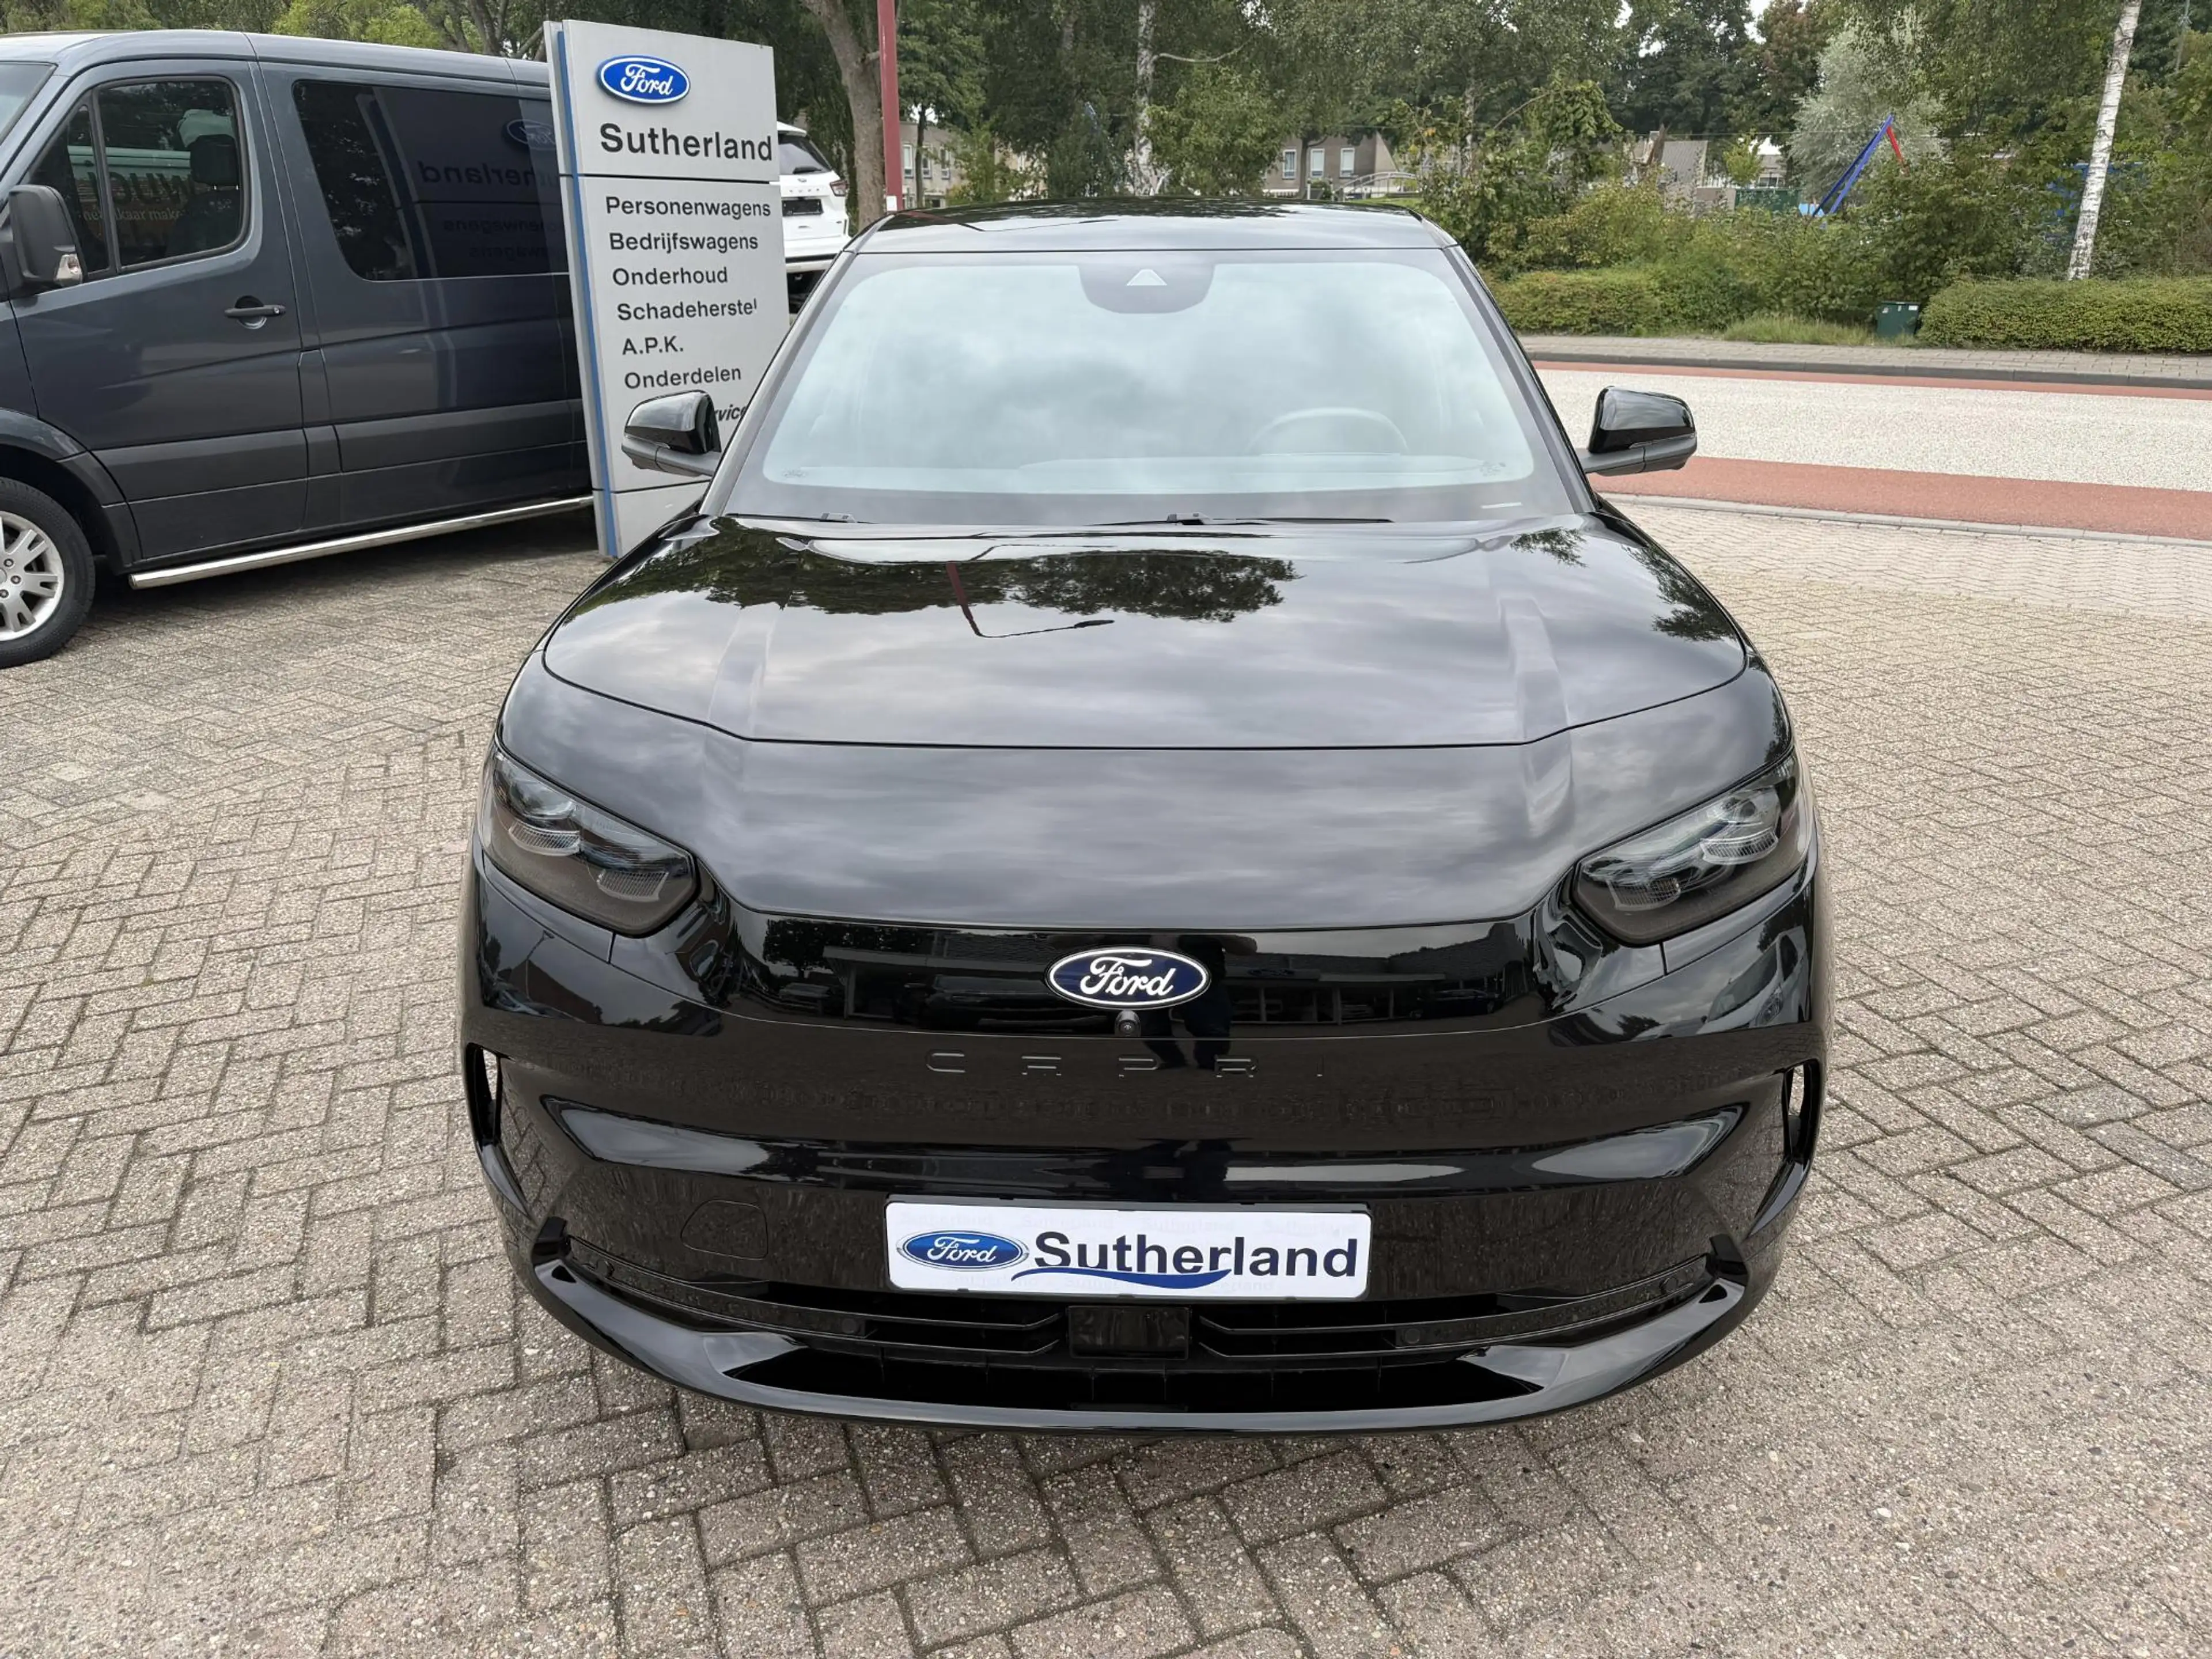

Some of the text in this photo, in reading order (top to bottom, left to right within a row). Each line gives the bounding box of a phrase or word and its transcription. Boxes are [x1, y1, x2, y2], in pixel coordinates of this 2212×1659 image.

[620, 63, 674, 95] Ford
[600, 123, 772, 161] Sutherland
[605, 196, 771, 220] Personenwagens
[609, 232, 759, 254] Bedrijfswagens
[612, 266, 728, 286] Onderhoud
[617, 297, 757, 321] Schadeherstel
[622, 336, 684, 355] A.P.K.
[624, 366, 742, 389] Onderdelen
[1080, 956, 1177, 995] Ford
[926, 1230, 1358, 1278] Ford Sutherland
